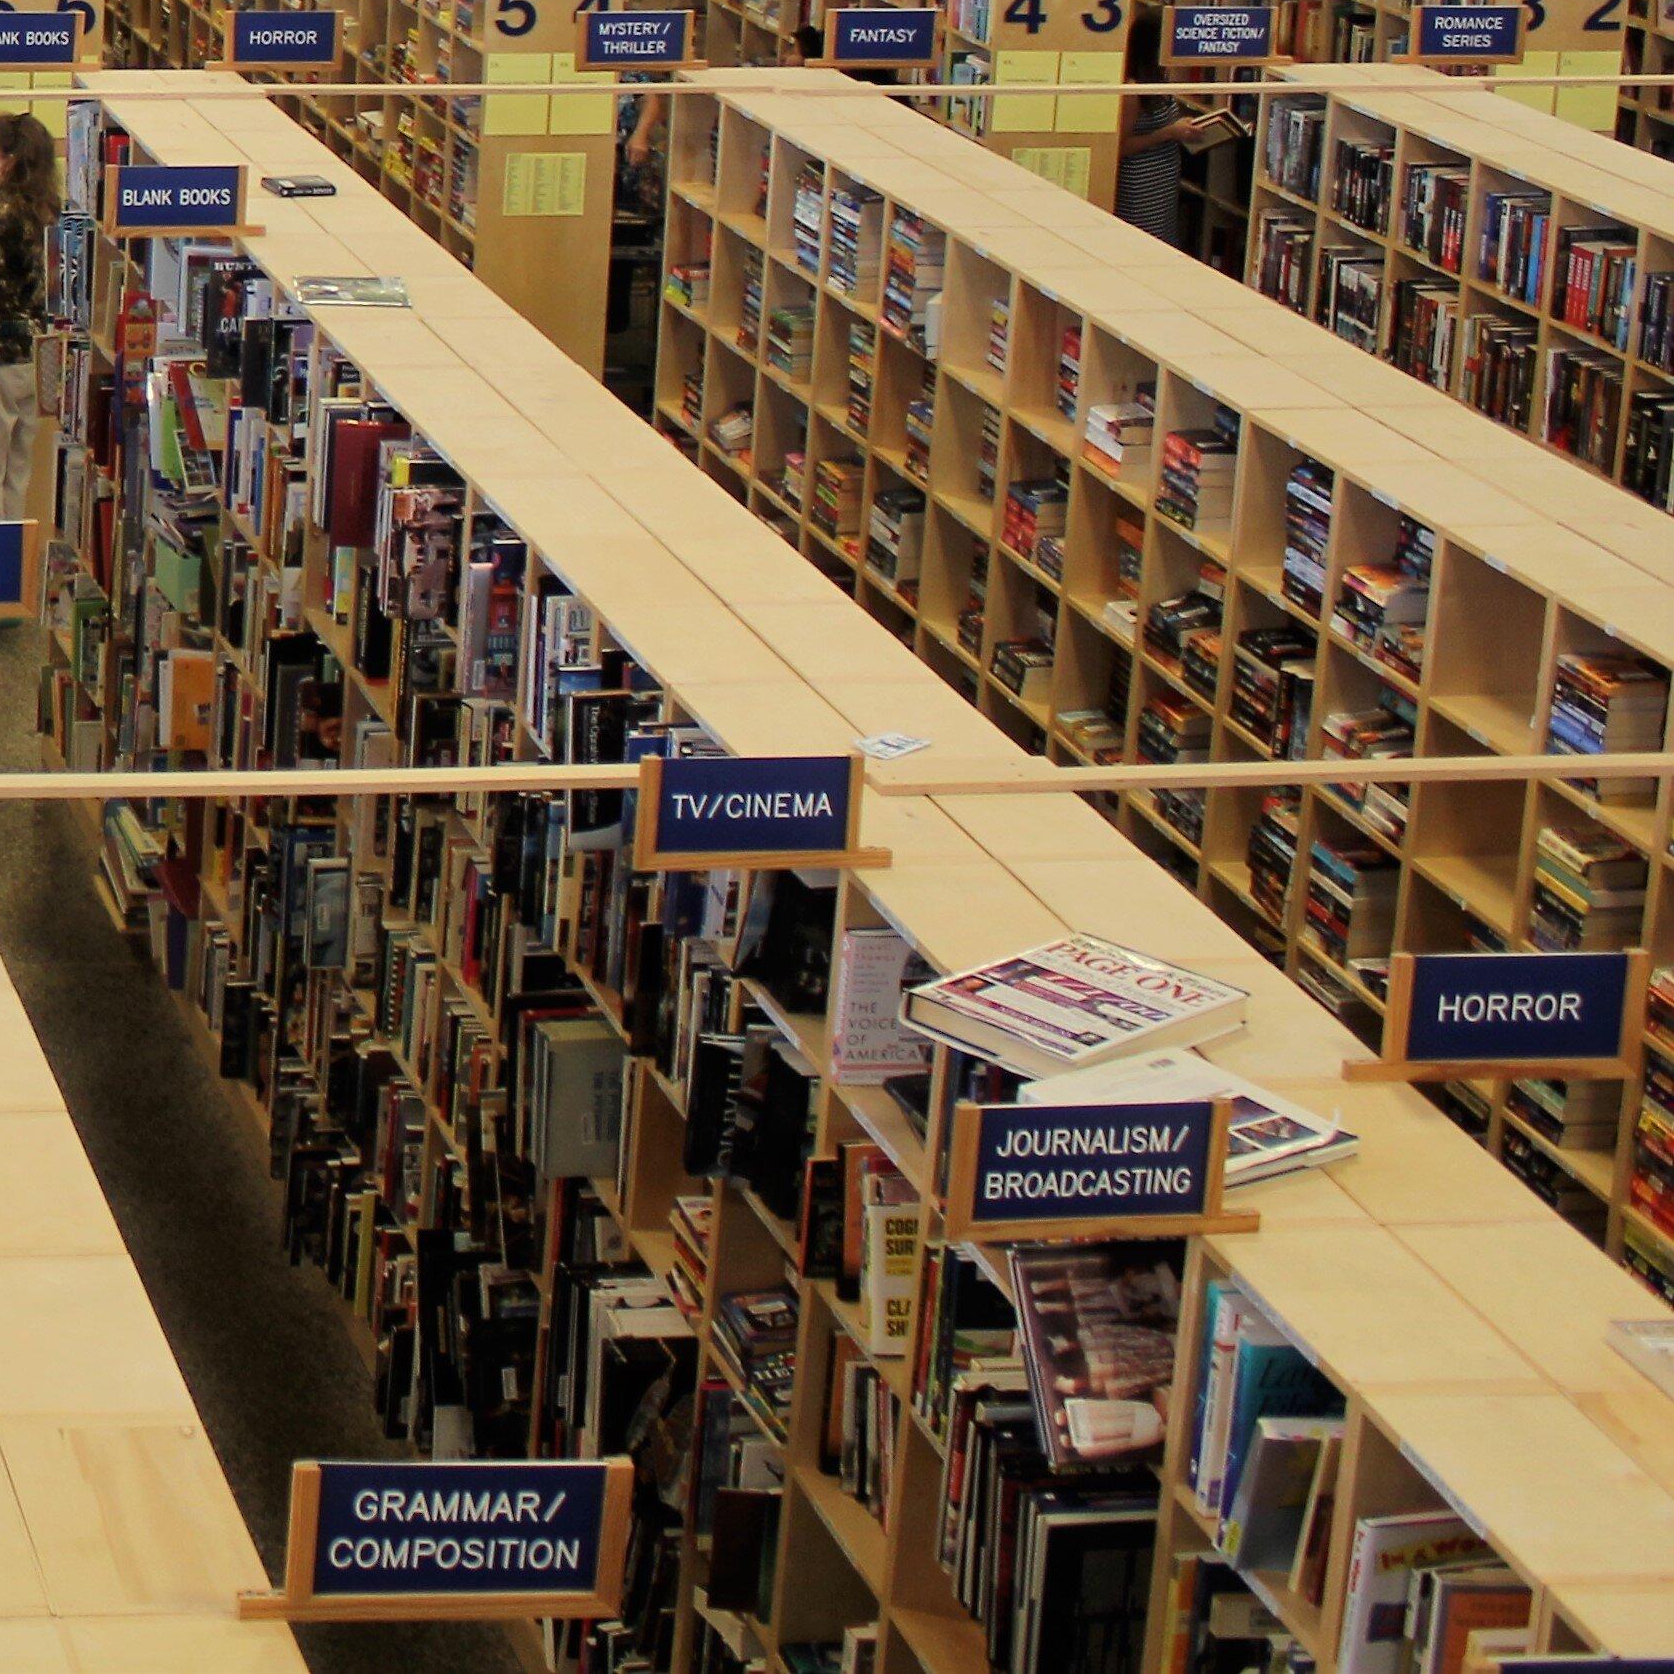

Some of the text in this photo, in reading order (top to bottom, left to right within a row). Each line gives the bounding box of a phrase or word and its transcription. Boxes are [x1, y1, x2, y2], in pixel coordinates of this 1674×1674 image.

[1193, 13, 1250, 26] OVERSIZED
[1434, 16, 1504, 30] ROMANCE
[598, 21, 671, 36] MYSTERY/
[850, 28, 917, 43] FANTASY
[1175, 26, 1265, 40] SCIENCE FICTION/
[25, 30, 70, 46] BOOKS
[249, 30, 318, 46] HORROR
[1442, 34, 1492, 48] SERIES
[602, 40, 667, 55] THRILLER
[1198, 40, 1240, 53] FANTASY
[122, 188, 231, 207] BLANK BOOKS
[672, 792, 833, 819] TV/CINEMA
[1045, 941, 1214, 1008] PAGE ONE
[851, 1001, 878, 1015] THE
[1438, 992, 1582, 1023] HORROR
[848, 1017, 898, 1030] VOICE
[846, 1034, 866, 1046] OF
[845, 1049, 919, 1061] AMERICA
[996, 1124, 1190, 1158] JOURNALISM/
[984, 1166, 1192, 1200] BROADCASTING
[354, 1489, 566, 1522] GRAMMAR/
[328, 1537, 580, 1569] COMPOSITION
